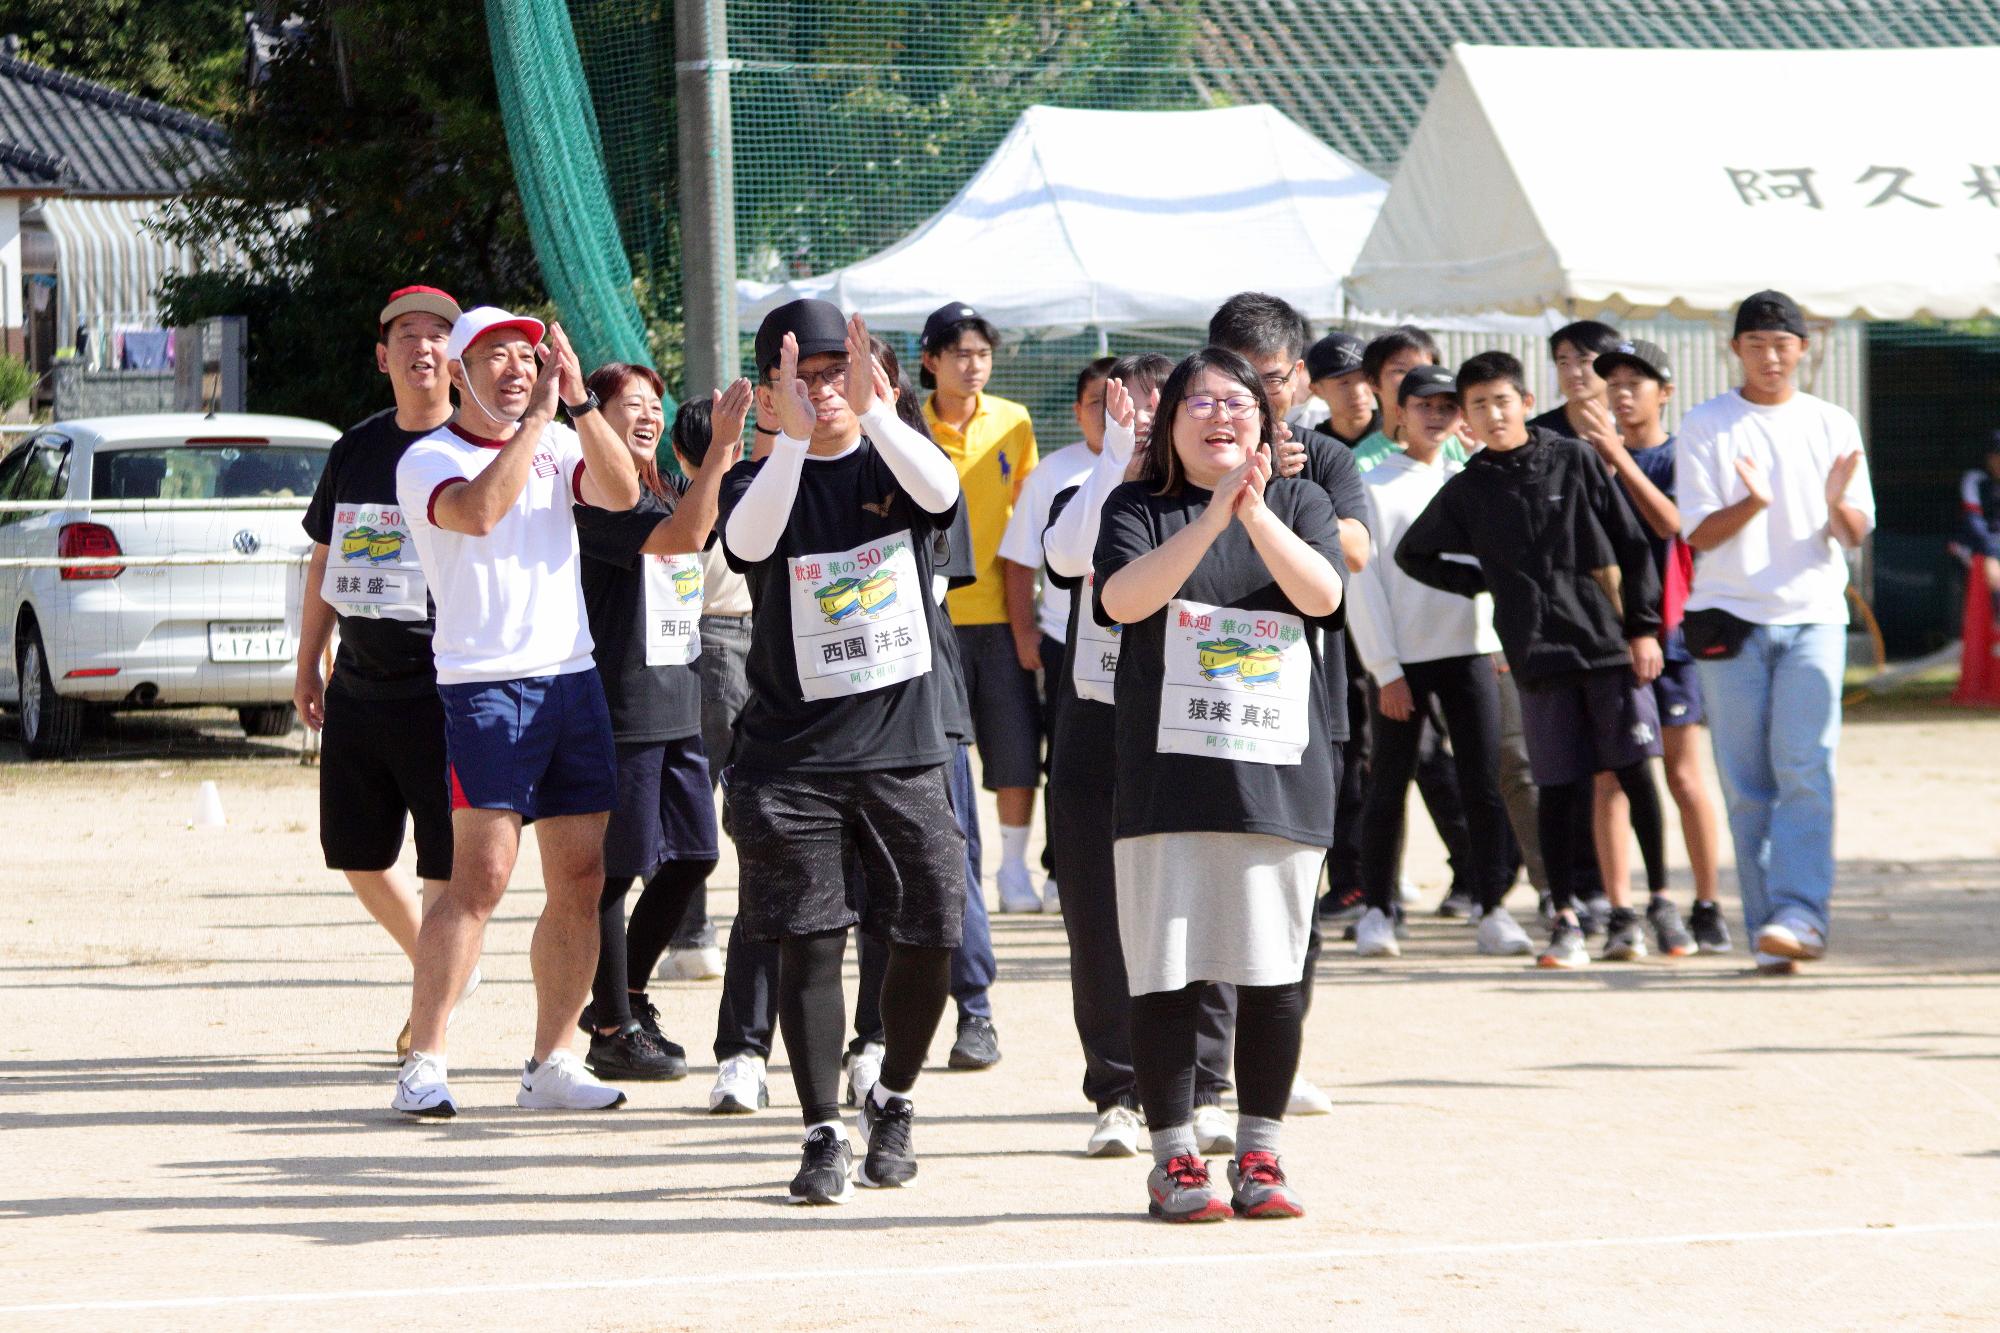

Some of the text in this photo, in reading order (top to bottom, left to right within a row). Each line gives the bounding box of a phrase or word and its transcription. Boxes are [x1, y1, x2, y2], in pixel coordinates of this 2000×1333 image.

[794, 563, 822, 581] 歓迎
[336, 576, 401, 594] 猿楽 盛一
[660, 620, 691, 637] 西田
[1179, 611, 1212, 632] 歓迎
[821, 626, 913, 664] 西園 洋志
[1100, 652, 1118, 672] 佐
[1188, 697, 1281, 730] 猿楽 真紀
[1206, 735, 1257, 751] 阿久根市
